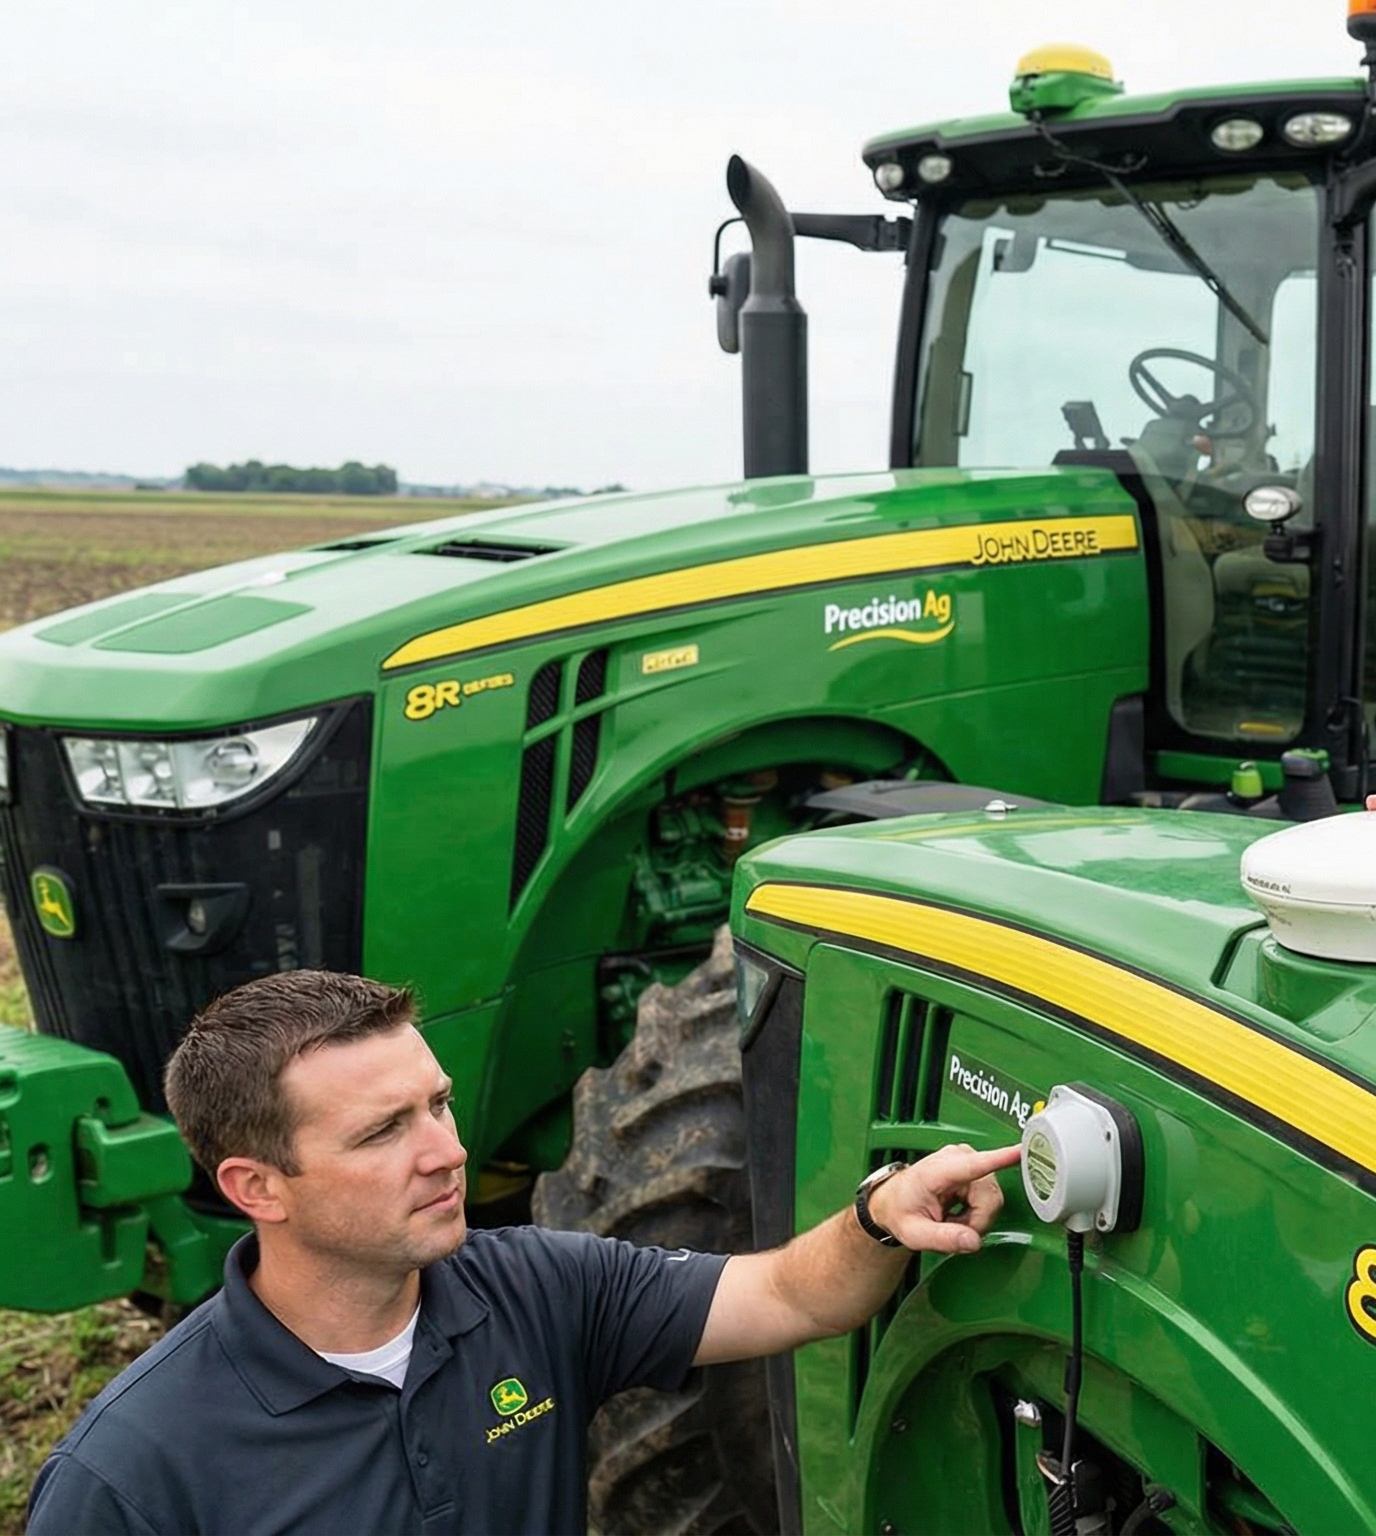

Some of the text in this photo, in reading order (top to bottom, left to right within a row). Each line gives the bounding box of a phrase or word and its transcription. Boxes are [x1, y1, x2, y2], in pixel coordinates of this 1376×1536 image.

[972, 529, 1098, 562] JOHN DEERE
[824, 589, 951, 634] Precision Ag
[404, 679, 461, 720] 8R
[949, 1054, 1031, 1129] Precision Ag
